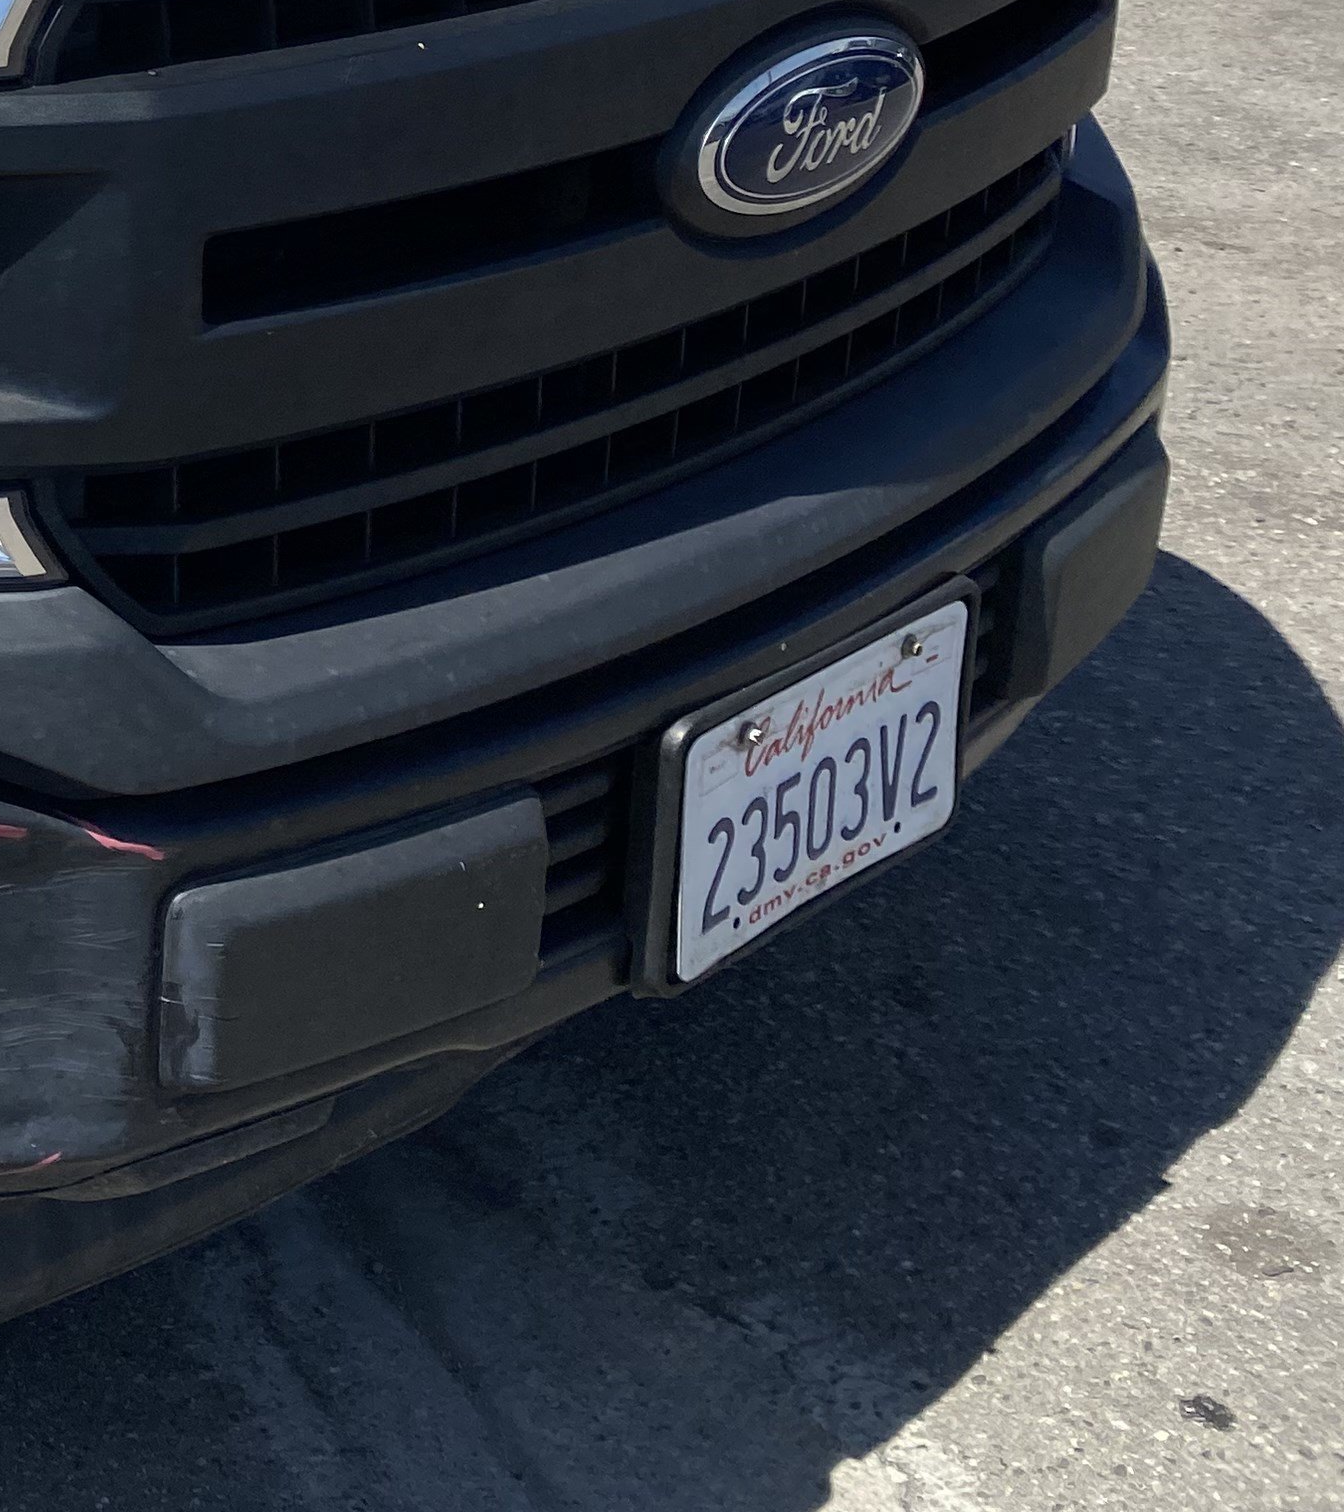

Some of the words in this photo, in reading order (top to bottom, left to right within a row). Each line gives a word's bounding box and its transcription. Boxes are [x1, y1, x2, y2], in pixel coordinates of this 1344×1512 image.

[766, 76, 887, 183] Ford
[744, 662, 912, 776] California
[701, 701, 941, 935] 23503V2
[748, 832, 889, 925] dmv.ca.gov
